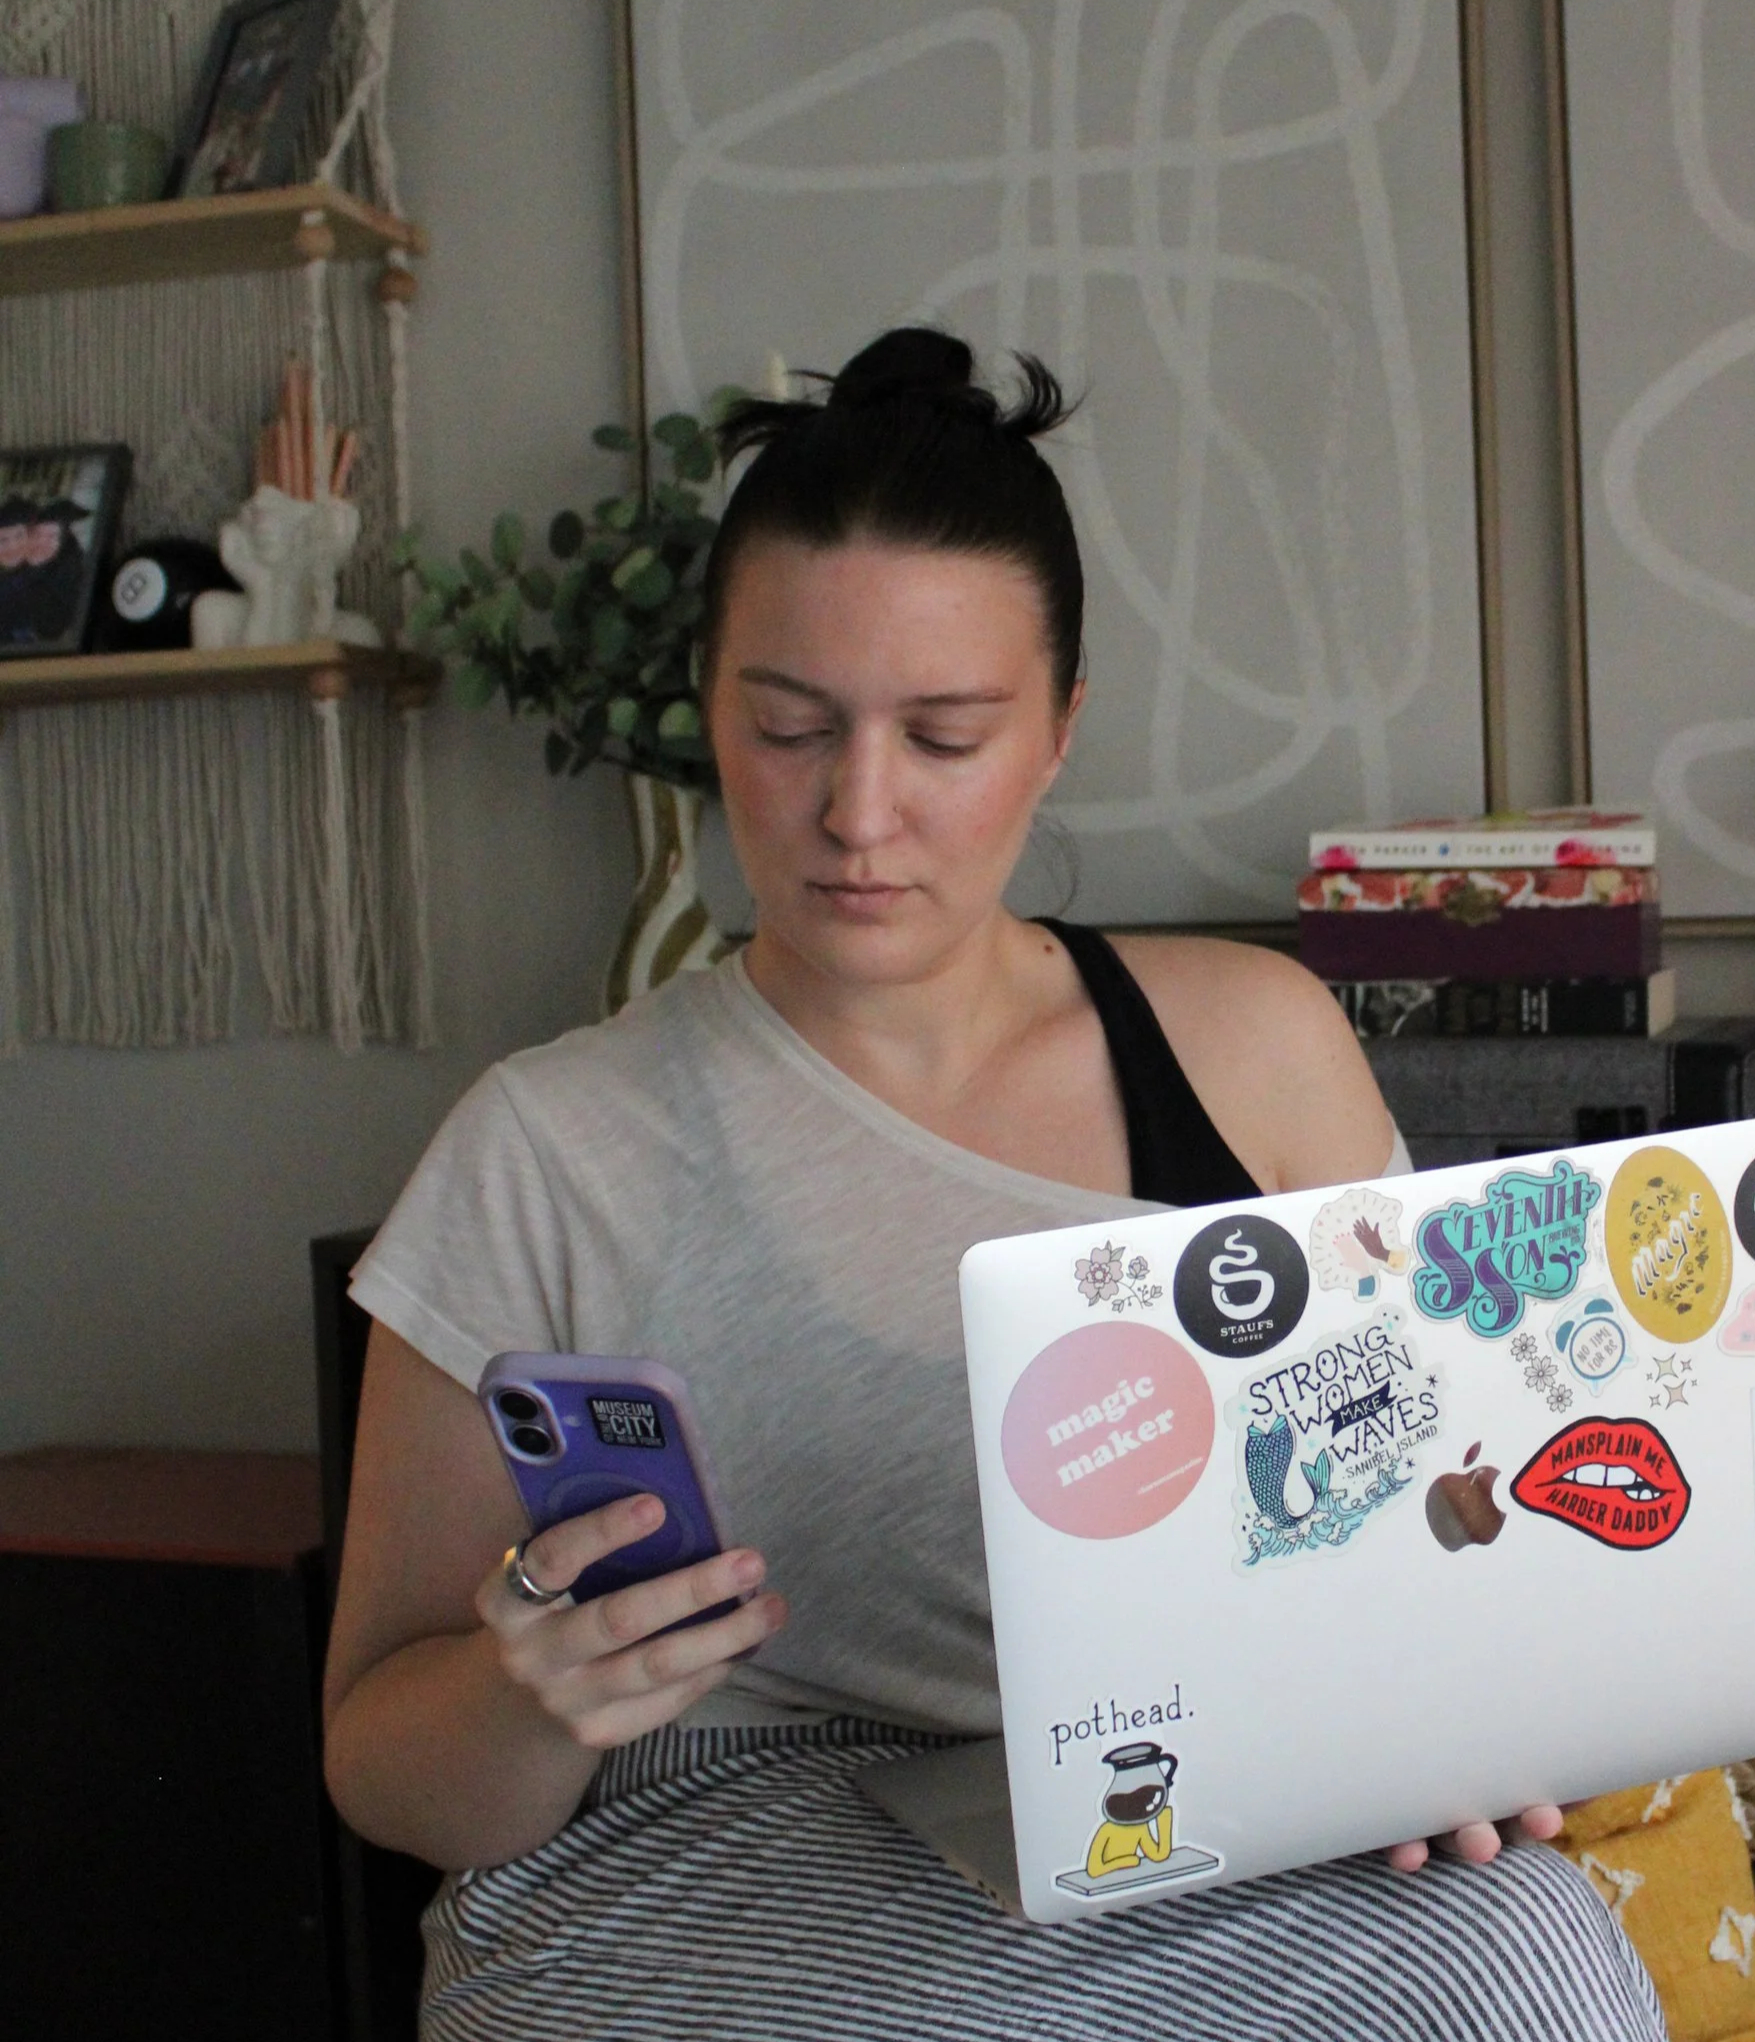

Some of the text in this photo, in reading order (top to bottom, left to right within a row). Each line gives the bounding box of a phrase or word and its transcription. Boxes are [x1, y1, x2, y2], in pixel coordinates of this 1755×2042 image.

[1423, 1179, 1584, 1312] SEVENTH
[1473, 1233, 1547, 1332] SON
[1232, 1333, 1263, 1344] COFFEE
[1577, 1326, 1612, 1363] NO TIME
[1587, 1339, 1618, 1371] FOR BS
[1250, 1326, 1395, 1415] STRONG
[1289, 1344, 1413, 1434] WOMEN
[592, 1400, 654, 1417] MUSEUM
[609, 1414, 655, 1438] CITY
[1046, 1376, 1155, 1447] magic
[1328, 1392, 1439, 1462] WAVES
[1339, 1394, 1384, 1425] MAKE
[1056, 1409, 1175, 1488] maker
[1345, 1424, 1438, 1479] SANIBEL ISLAND
[1551, 1431, 1669, 1479] MANSPLAIN ME
[1545, 1488, 1672, 1533] HARDER DADDY
[1050, 1684, 1194, 1765] pothead.
